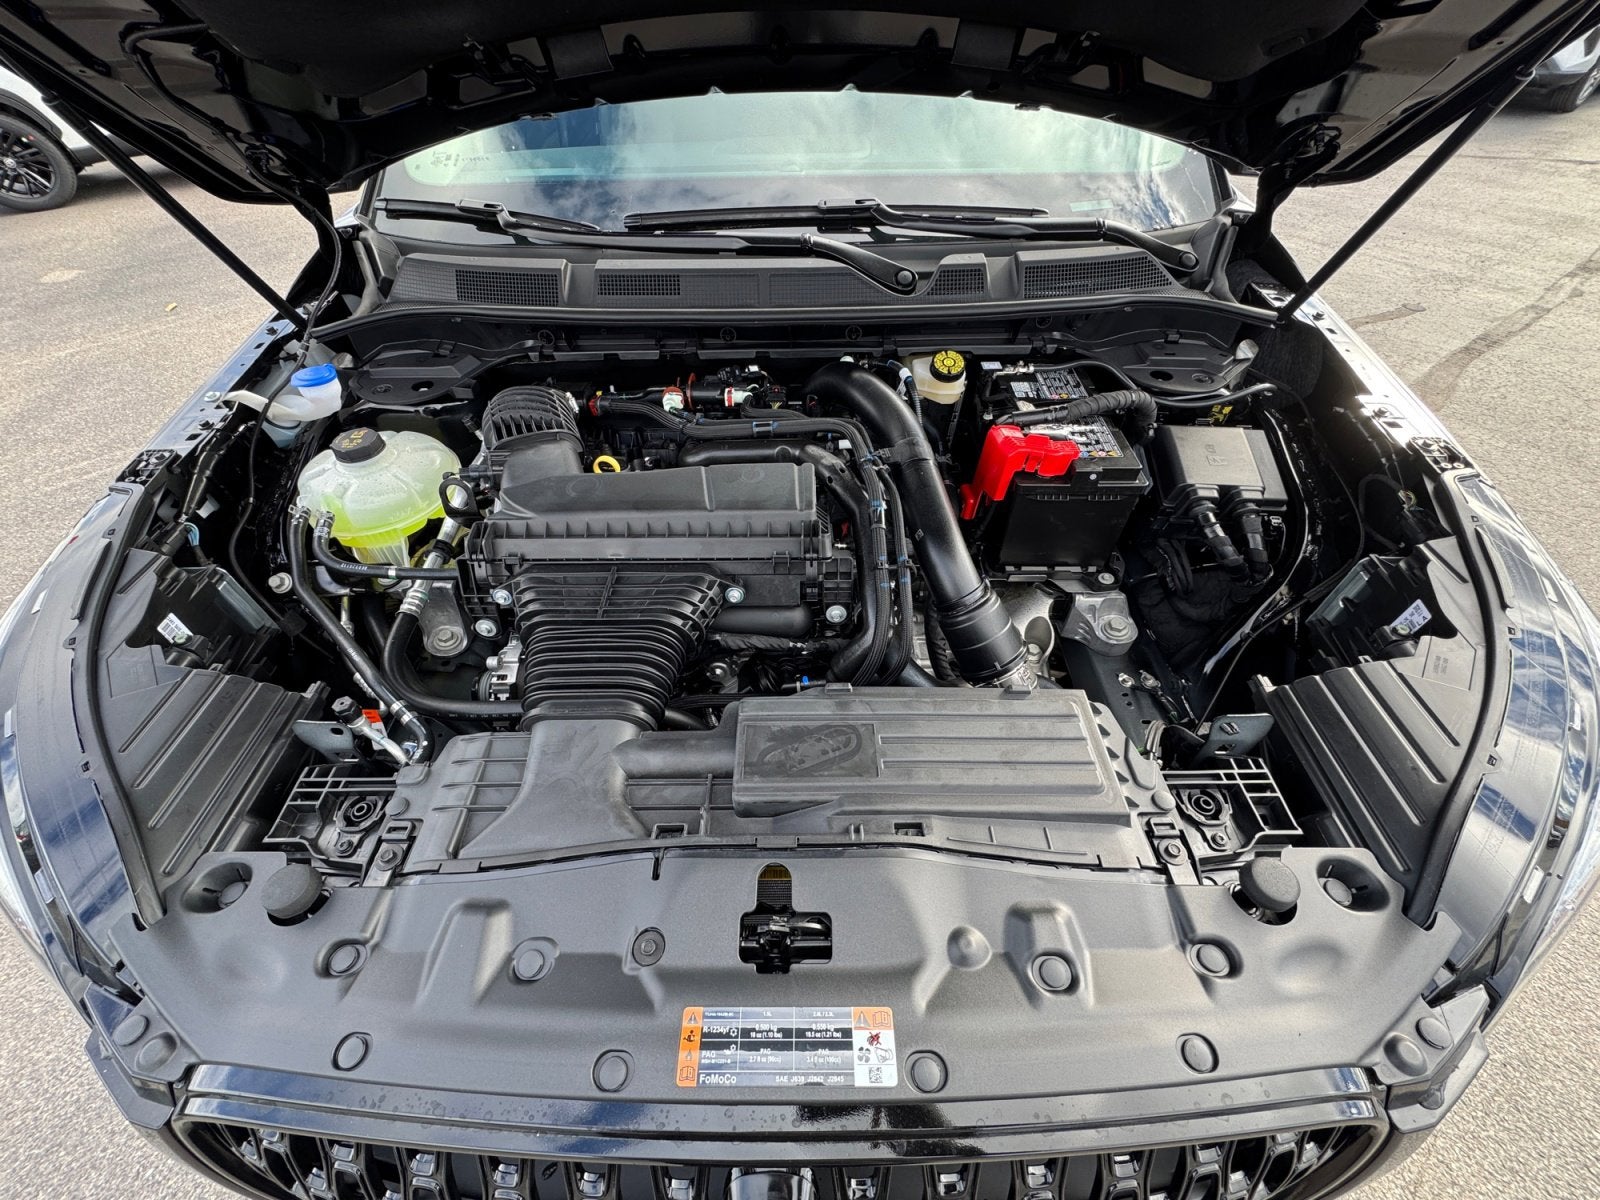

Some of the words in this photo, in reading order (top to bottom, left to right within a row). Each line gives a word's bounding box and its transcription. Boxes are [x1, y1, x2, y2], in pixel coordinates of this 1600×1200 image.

[703, 1025, 730, 1034] R-1234yf
[770, 1023, 778, 1032] kg
[827, 1023, 835, 1032] kg
[701, 1050, 716, 1058] PAG
[700, 1074, 737, 1084] FoMoCo
